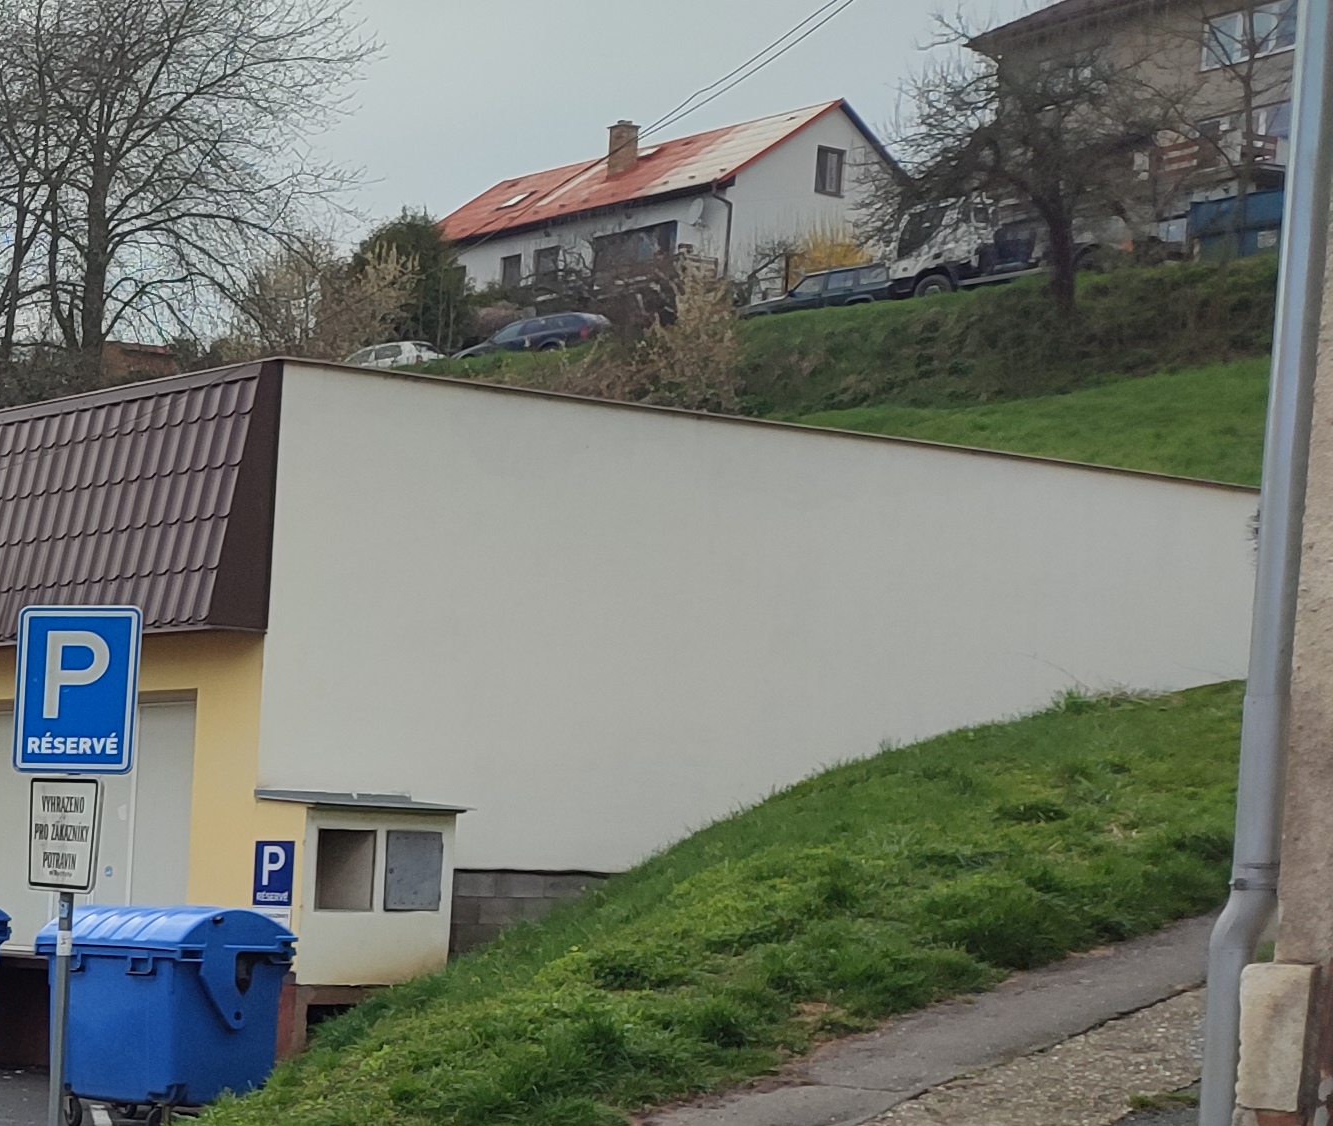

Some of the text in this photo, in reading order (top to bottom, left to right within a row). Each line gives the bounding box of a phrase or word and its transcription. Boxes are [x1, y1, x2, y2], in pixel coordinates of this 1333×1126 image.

[42, 630, 110, 719] P
[26, 731, 119, 755] RÉSERVÉ
[42, 795, 85, 814] VYHRAZENO
[34, 820, 90, 843] PRO ZÁKAZNÍKY
[42, 851, 77, 870] POTRAVIN
[261, 845, 286, 886] P
